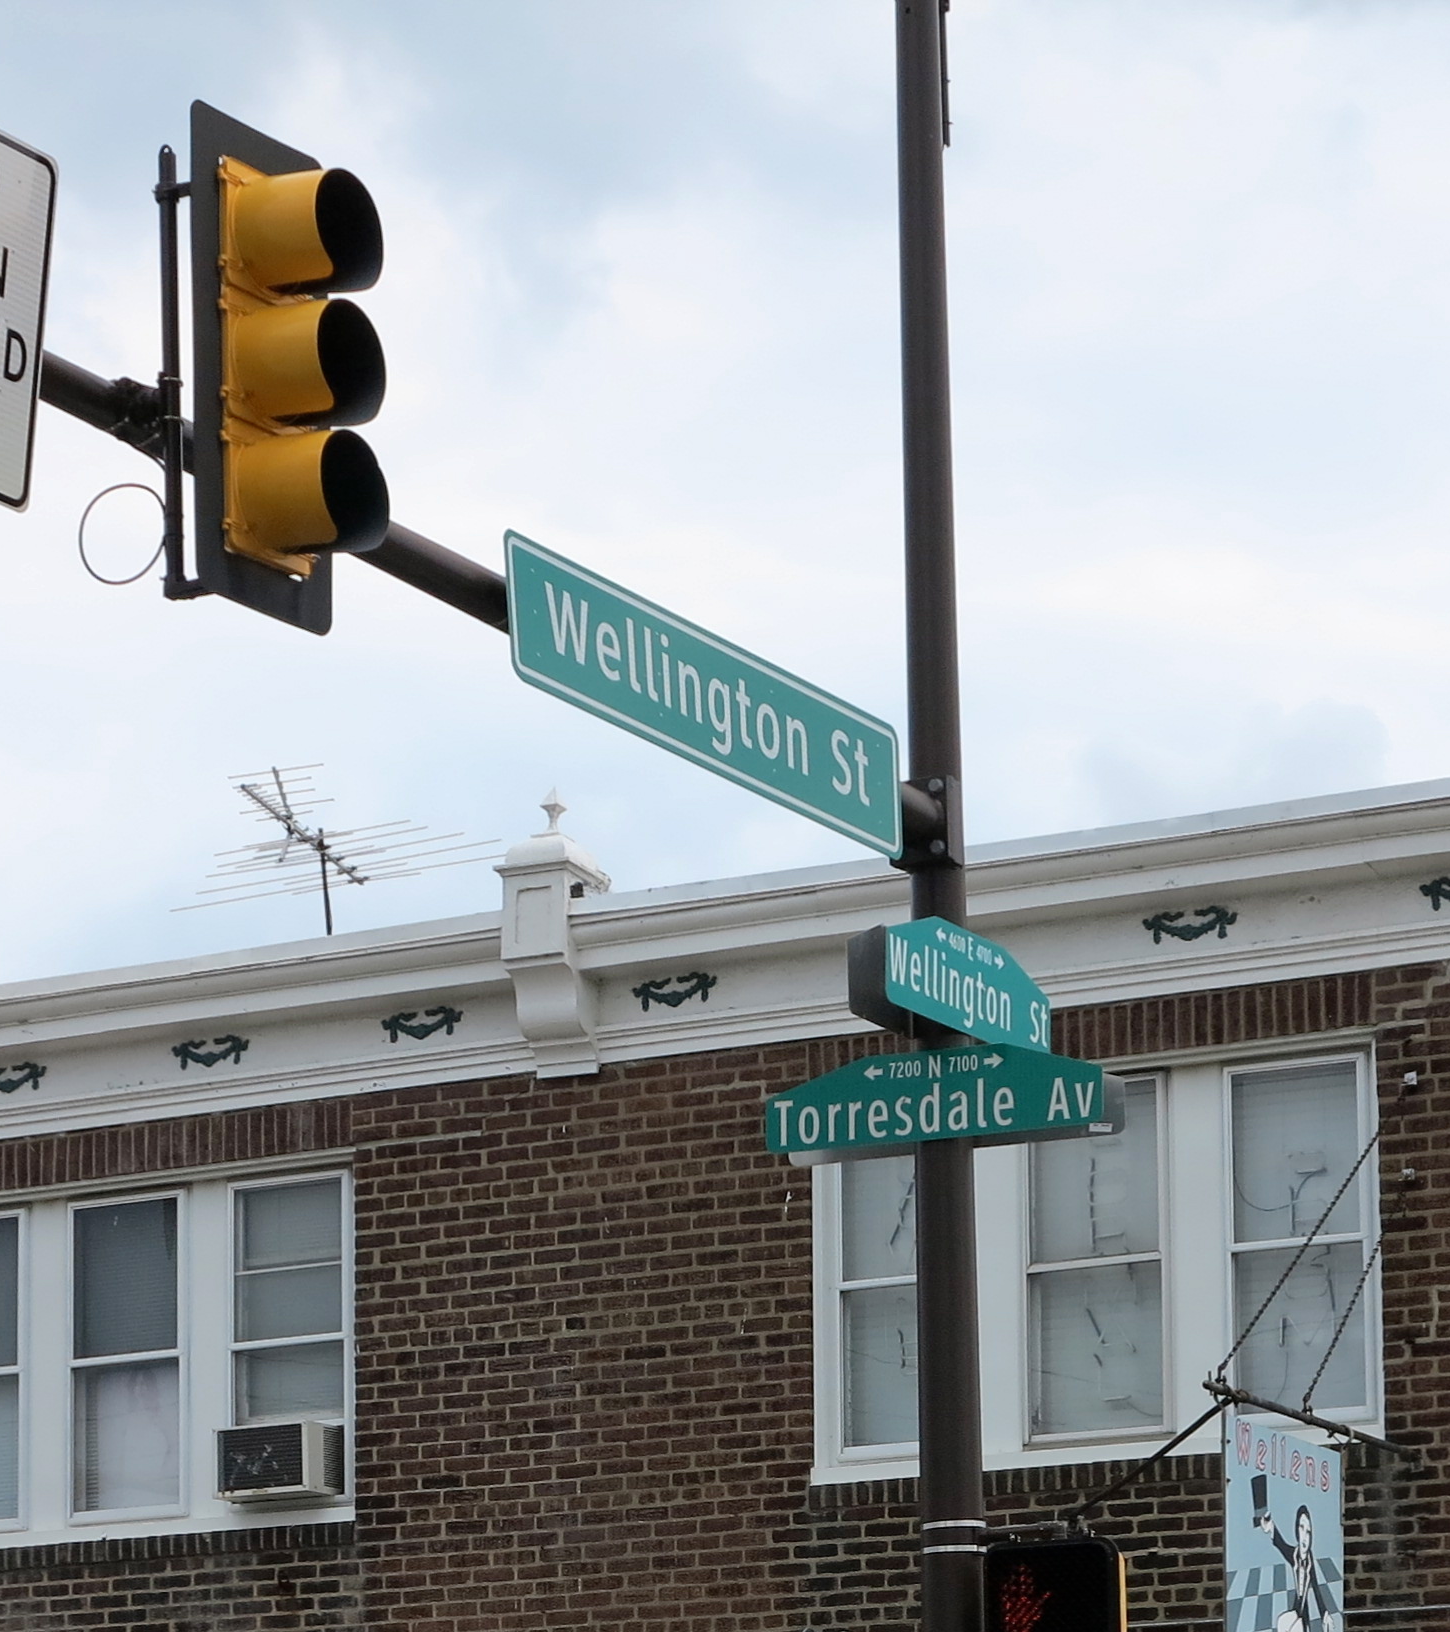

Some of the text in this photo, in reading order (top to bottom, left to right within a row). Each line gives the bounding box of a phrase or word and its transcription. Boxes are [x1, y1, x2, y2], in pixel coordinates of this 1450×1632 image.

[544, 580, 872, 807] Wellington St
[967, 936, 974, 962] E
[889, 932, 1048, 1048] Wellington St
[889, 1054, 979, 1079] 7200 N 7100
[774, 1076, 1095, 1148] Torresdale Av
[1235, 1418, 1330, 1492] Wellens
